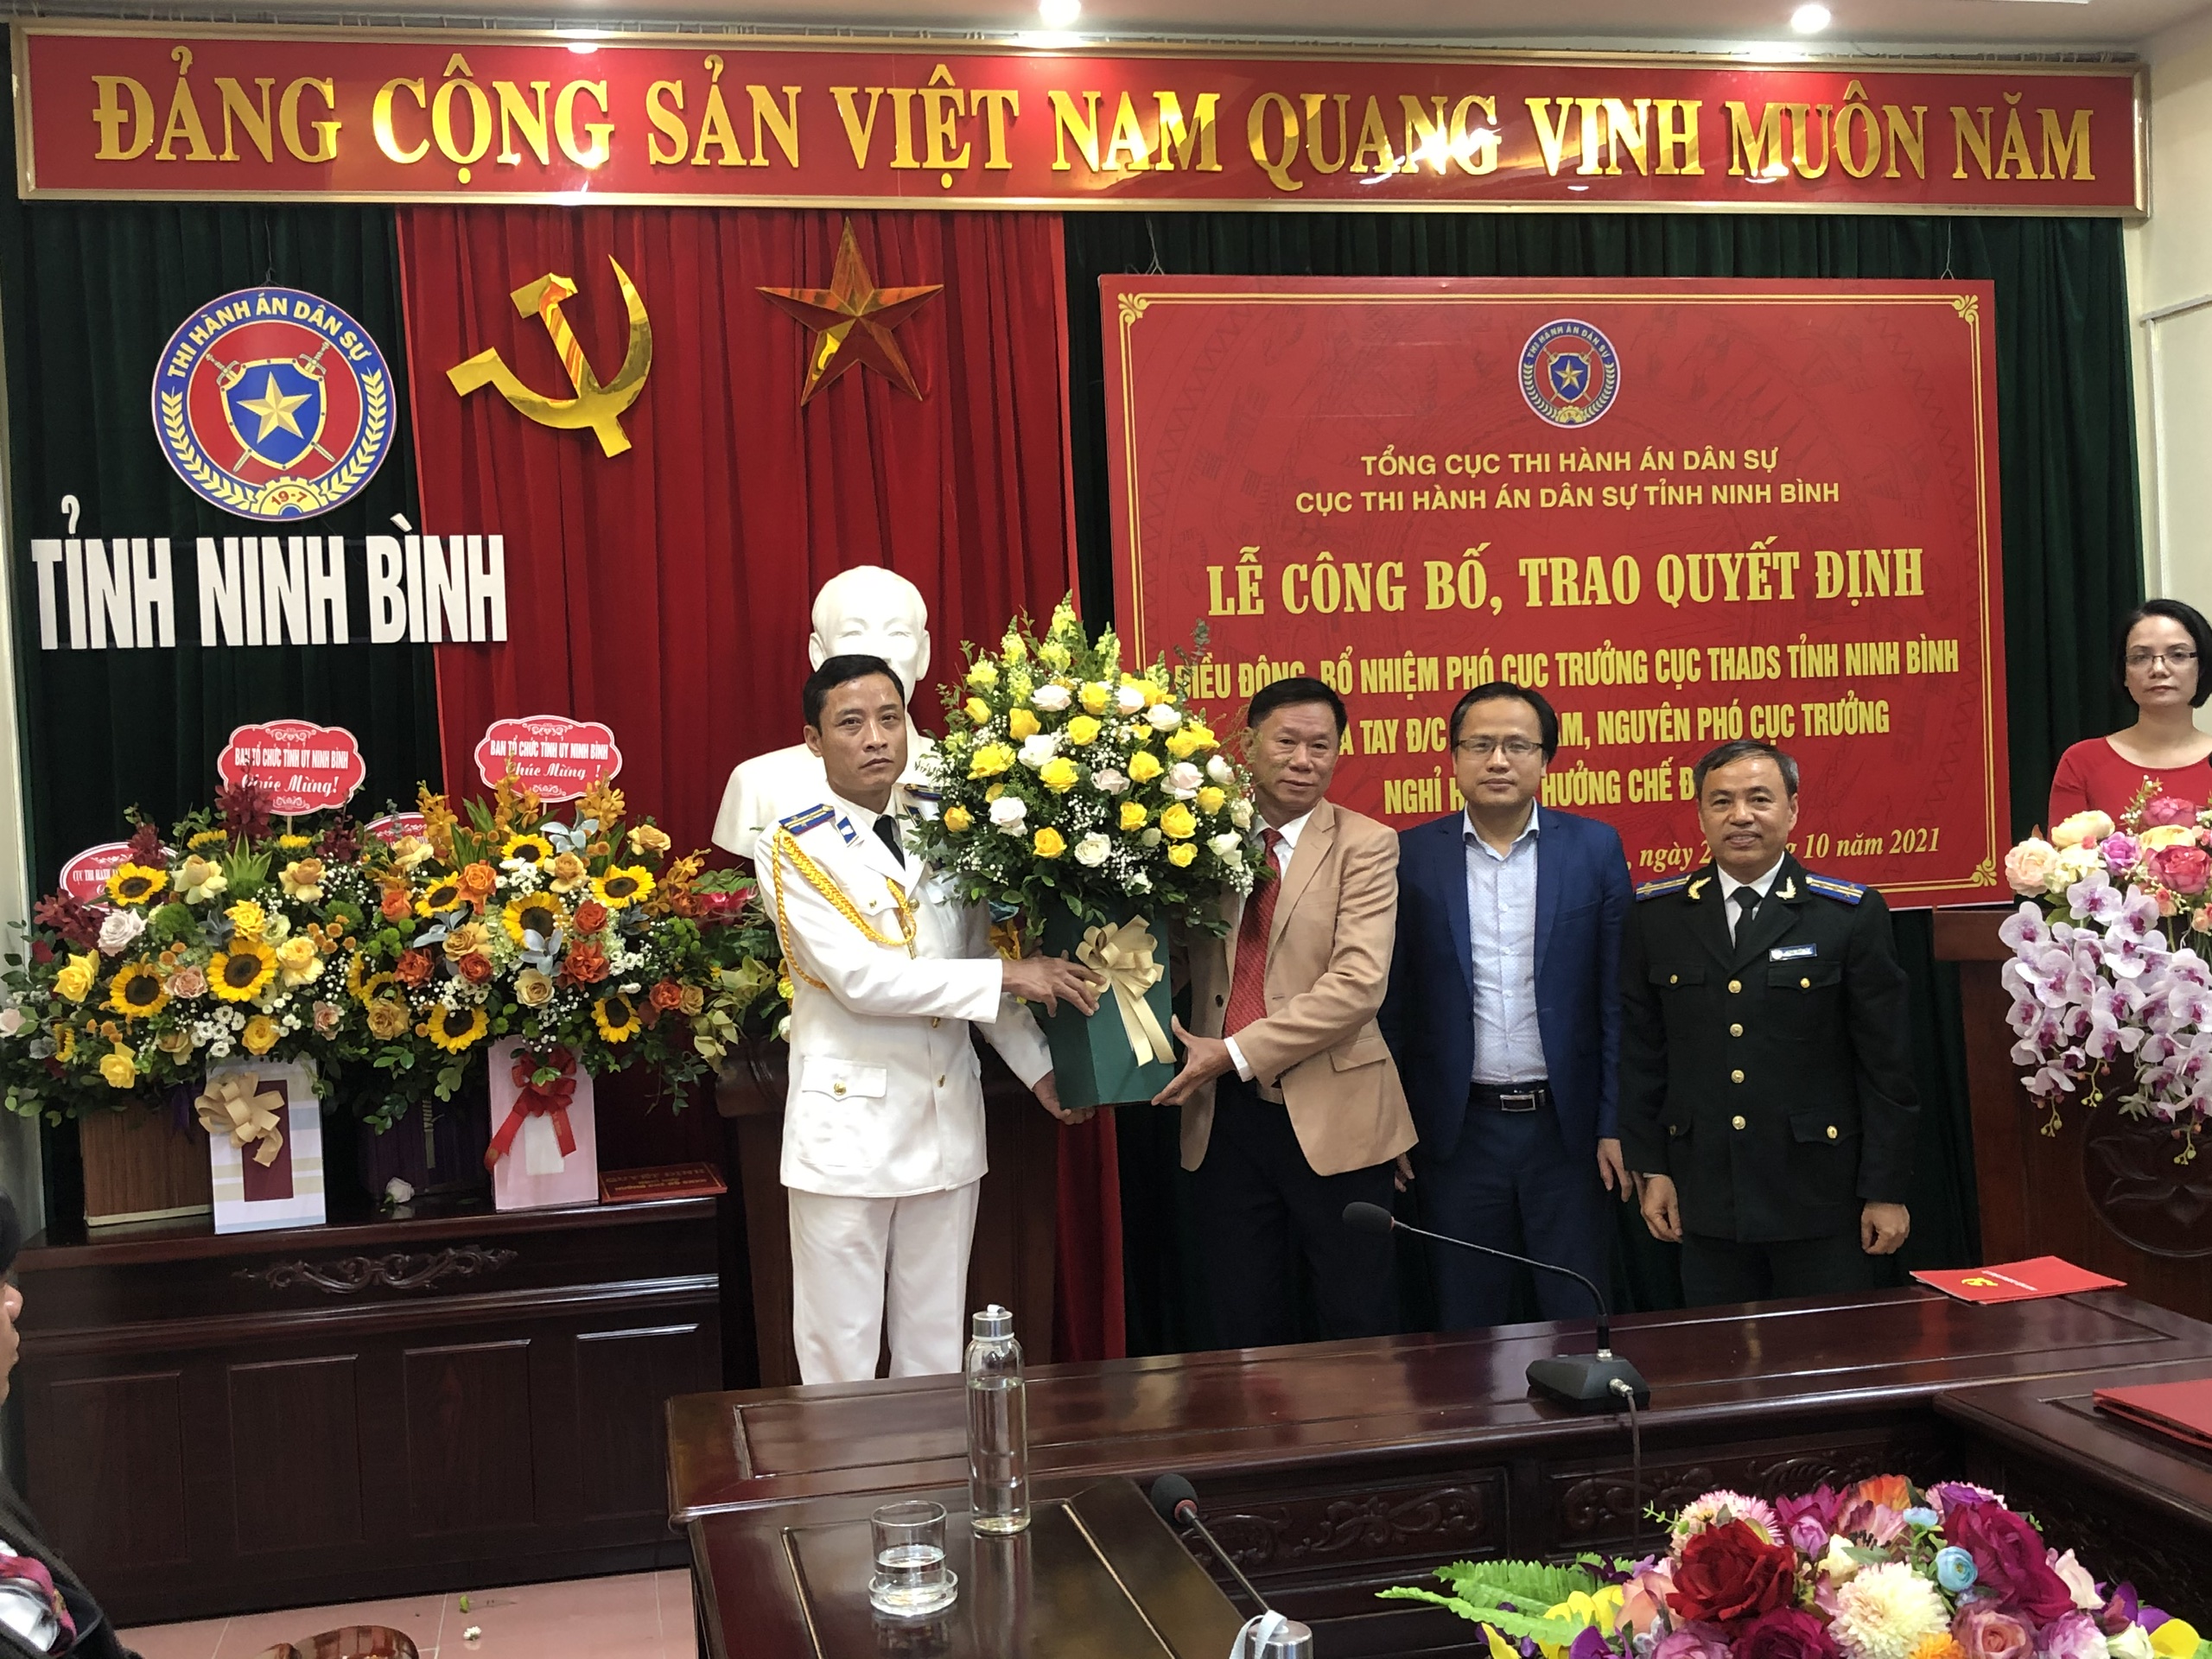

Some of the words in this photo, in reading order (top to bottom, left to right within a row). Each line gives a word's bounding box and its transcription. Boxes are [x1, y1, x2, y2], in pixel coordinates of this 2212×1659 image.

[92, 45, 342, 163] ĐẢNG
[372, 53, 615, 184] CỘNG
[645, 54, 802, 168] SẢN
[830, 64, 1020, 189] VIỆT
[1048, 91, 1223, 173] NAM
[1248, 92, 1503, 191] QUANG
[1525, 97, 1705, 176] VINH
[1724, 79, 1929, 180] MUÔN
[1949, 92, 2095, 181] NĂM
[168, 341, 197, 378] THI
[188, 300, 251, 346] HÀNH
[256, 292, 288, 316] ÁN
[293, 301, 343, 337] DÂN
[339, 330, 372, 361] SỰ
[1526, 341, 1540, 359] THI
[1361, 443, 1436, 476] TỔNG
[1445, 454, 1501, 479] CỤC
[1508, 453, 1551, 474] THI
[1559, 447, 1631, 472] HÀNH
[1639, 445, 1675, 471] ÁN
[1683, 444, 1736, 470] DÂN
[1744, 446, 1779, 474] SỰ
[270, 490, 308, 506] 19-7
[1295, 492, 1352, 517] CỤC
[1360, 490, 1404, 512] THI
[1412, 484, 1487, 511] HÀNH
[1494, 482, 1530, 509] ÁN
[1540, 482, 1593, 508] DÂN
[1602, 483, 1638, 511] SỰ
[1643, 478, 1703, 505] TỈNH
[1712, 484, 1771, 505] NINH
[1780, 478, 1840, 503] BÌNH
[31, 494, 176, 651] TỈNH
[196, 536, 349, 647] NINH
[365, 512, 509, 644] BÌNH
[1206, 545, 1265, 616] LỄ
[1281, 551, 1408, 615] CÔNG
[1423, 542, 1503, 616] BỐ,
[1518, 555, 1642, 607] TRAO
[1656, 536, 1800, 609] QUYẾT
[1815, 548, 1925, 607] ĐỊNH
[1319, 645, 1353, 696] BỔ
[1360, 650, 1440, 700] NHIỆM
[1446, 648, 1495, 690] PHÓ
[1554, 639, 1649, 687] TRƯỞNG
[1655, 647, 1701, 690] CỤC
[1707, 645, 1782, 682] THADS
[1787, 633, 1839, 678] TỈNH
[1846, 642, 1900, 677] NINH
[1906, 632, 1959, 674] BÌNH
[490, 739, 506, 756] BAN
[518, 738, 539, 757] CHỨC
[541, 736, 558, 758] TỈNH
[570, 743, 589, 760] NINH
[590, 741, 609, 760] BÌNH
[1359, 719, 1399, 754] TAY
[1406, 716, 1446, 753] Đ/C
[1597, 701, 1691, 745] NGUYÊN
[1698, 697, 1743, 741] PHÓ
[1750, 703, 1796, 746] CỤC
[1802, 690, 1890, 736] TRƯỞNG
[262, 744, 283, 767] CHỨC
[312, 750, 330, 769] NINH
[331, 747, 349, 769] BÌNH
[1384, 766, 1442, 814] NGHỈ
[1541, 760, 1622, 808] HƯỞNG
[1628, 756, 1674, 803] CHẾ
[1639, 841, 1694, 873] ngày
[1803, 833, 1830, 859] 10
[1836, 832, 1884, 856] năm
[1889, 827, 1940, 855] 2021
